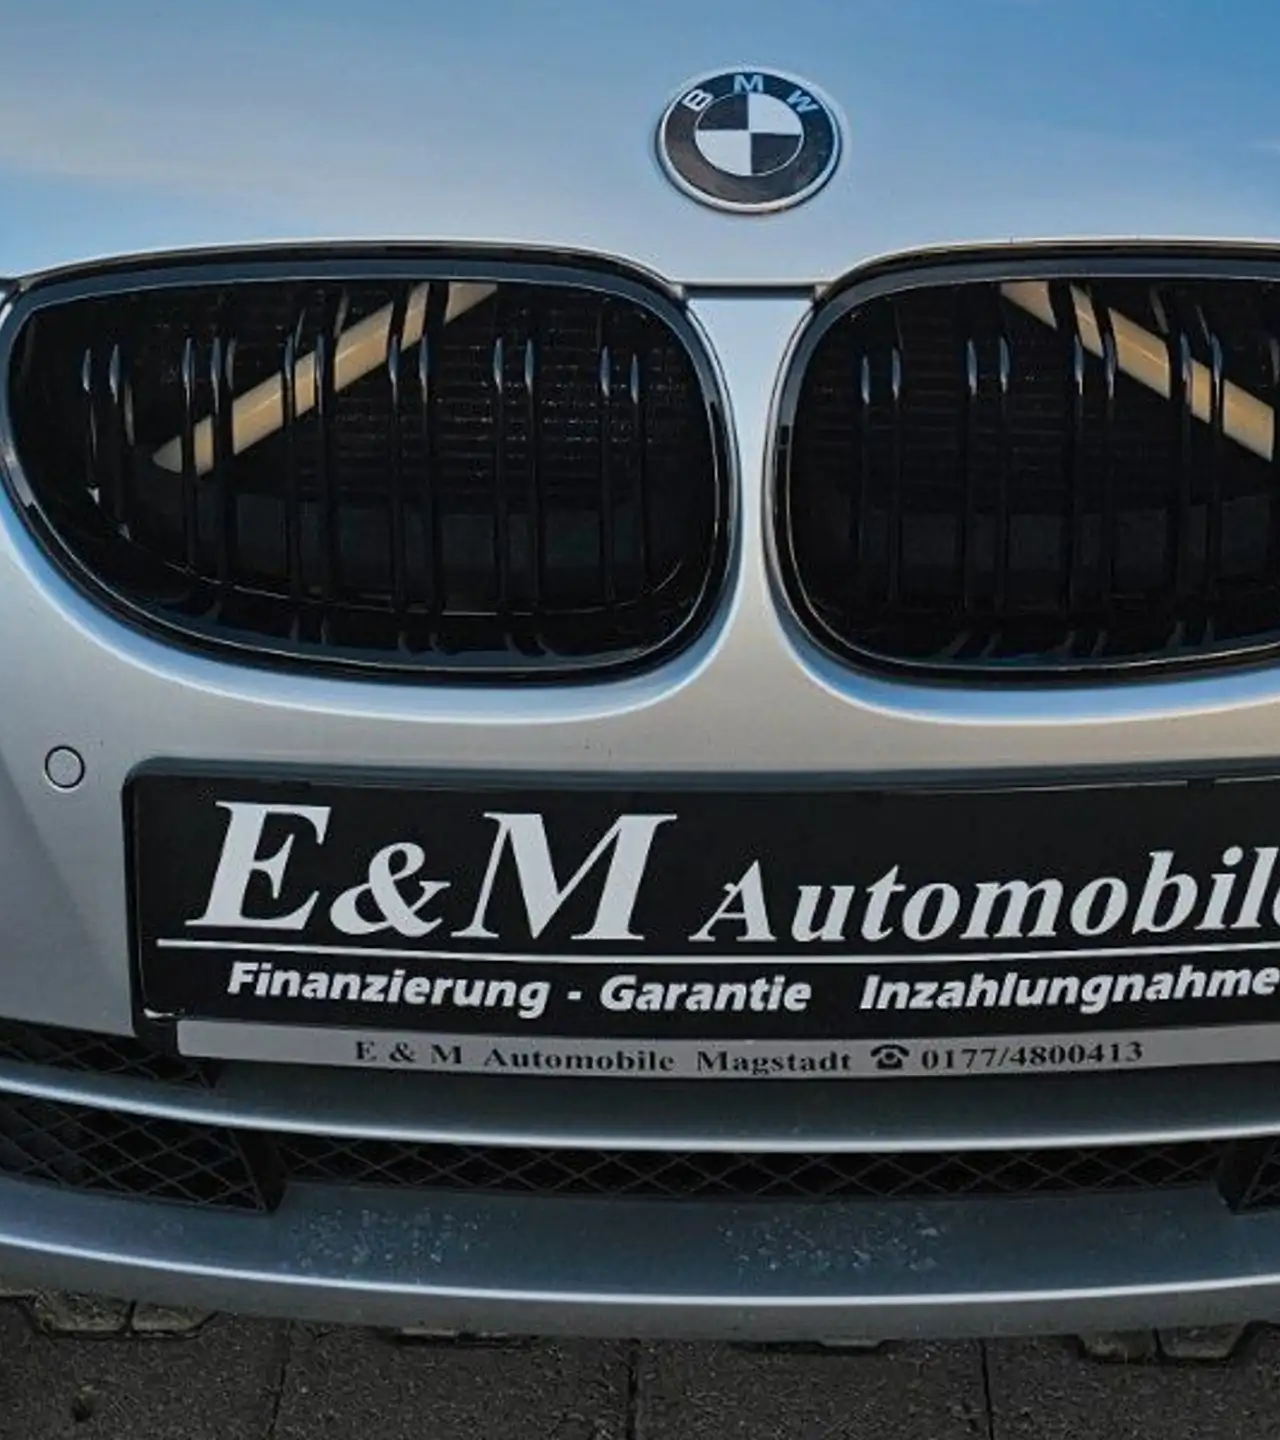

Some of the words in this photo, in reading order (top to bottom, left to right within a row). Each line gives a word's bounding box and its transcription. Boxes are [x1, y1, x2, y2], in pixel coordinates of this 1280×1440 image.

[682, 73, 819, 113] BMW
[184, 800, 678, 941] E&M
[227, 960, 552, 1019] Finanzierung
[600, 975, 813, 1013] Garantie
[355, 1039, 378, 1061] E
[388, 1040, 417, 1063] &
[430, 1044, 463, 1065] M
[483, 1046, 675, 1072] Automobile
[696, 1049, 851, 1076] Magstadt
[921, 1041, 1145, 1071] 0177/4800413
